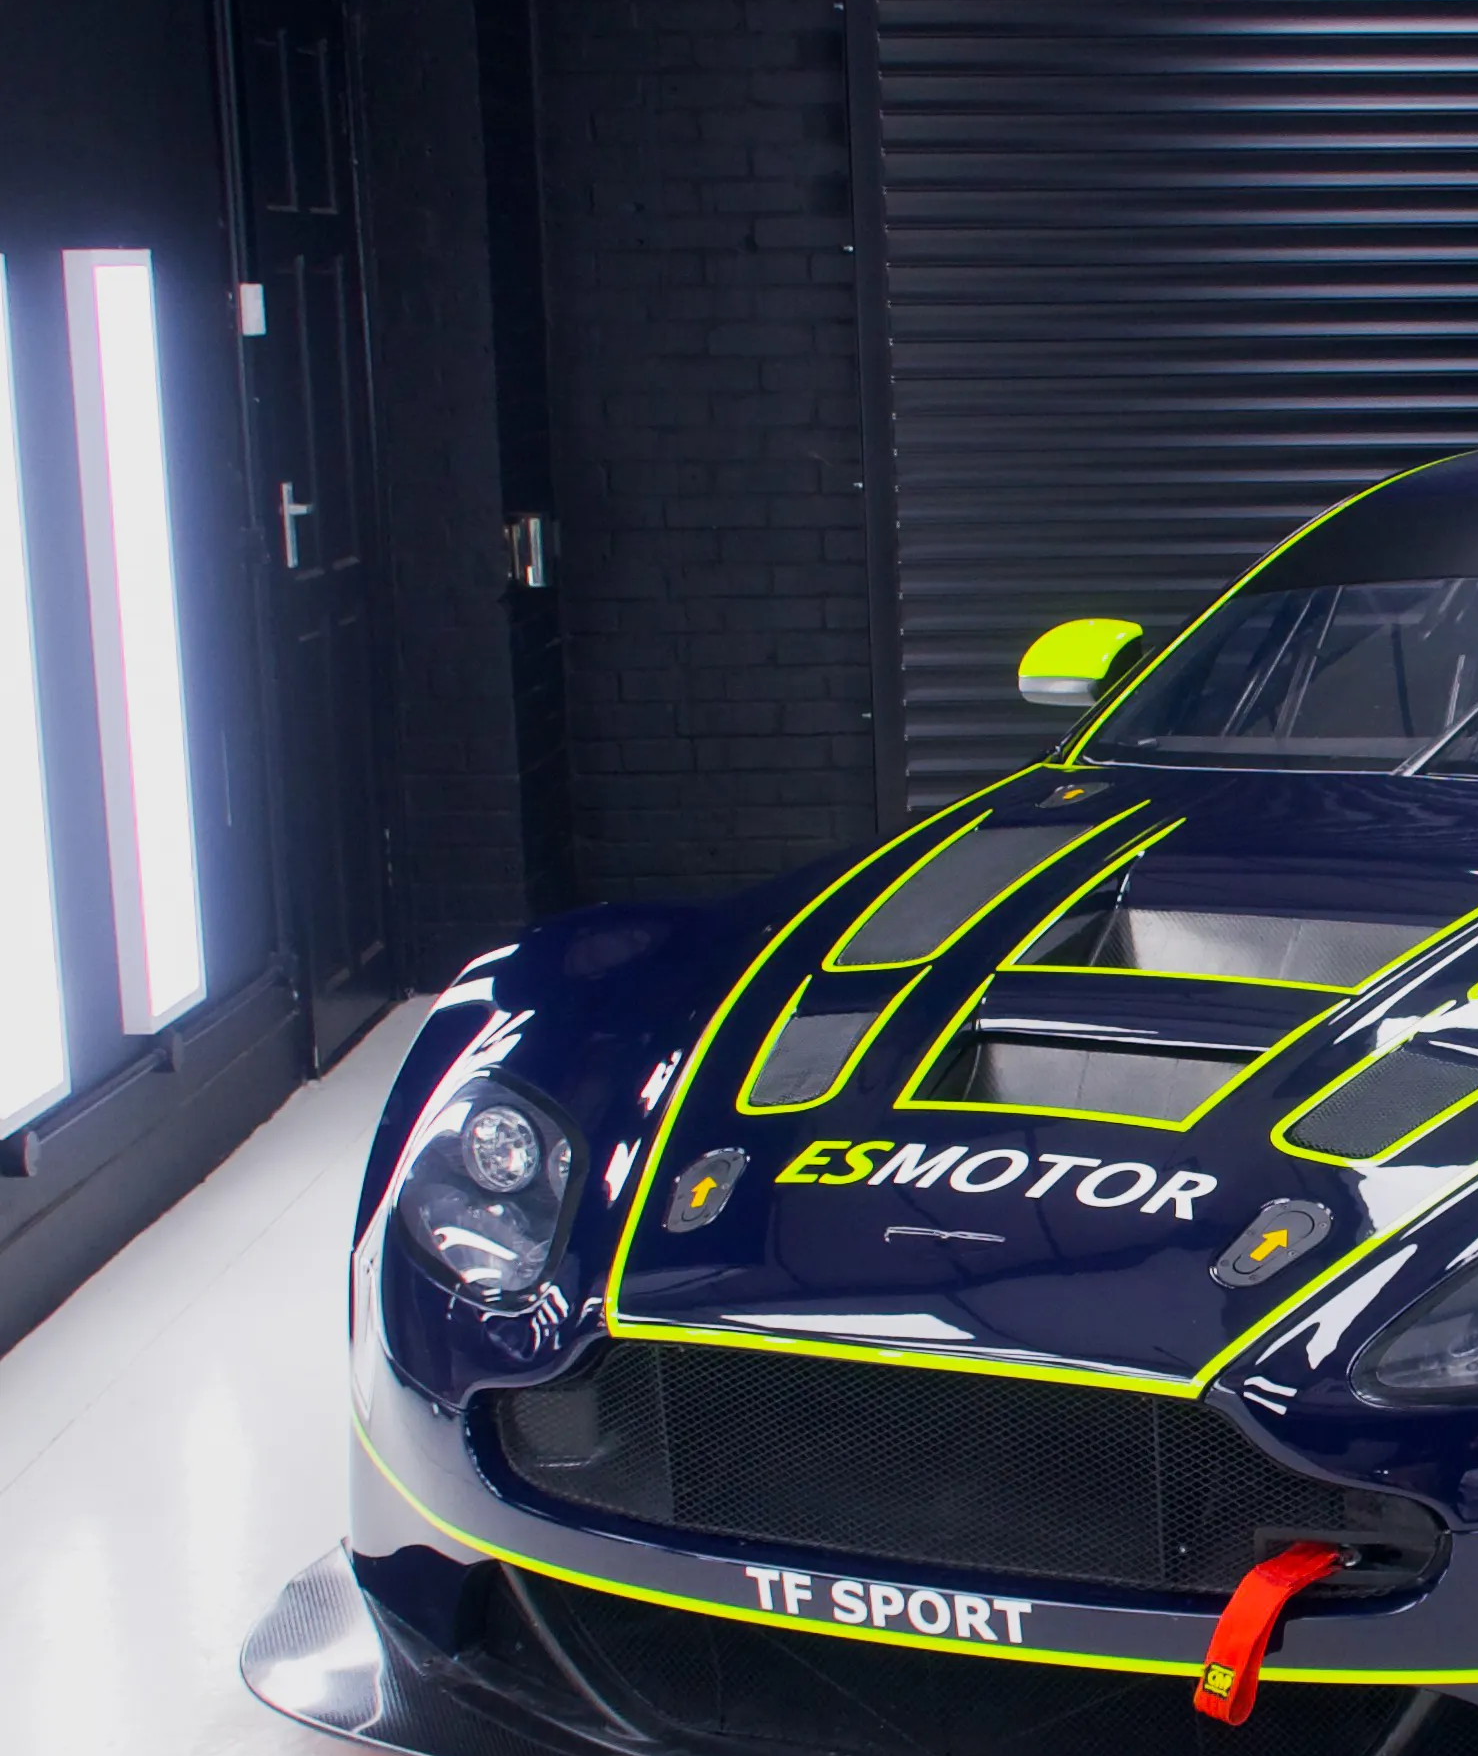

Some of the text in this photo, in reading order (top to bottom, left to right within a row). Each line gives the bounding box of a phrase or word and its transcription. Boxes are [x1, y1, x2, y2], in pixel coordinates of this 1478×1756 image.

[774, 1140, 1218, 1221] ESMOTOR
[745, 1566, 1032, 1644] TF SPORT
